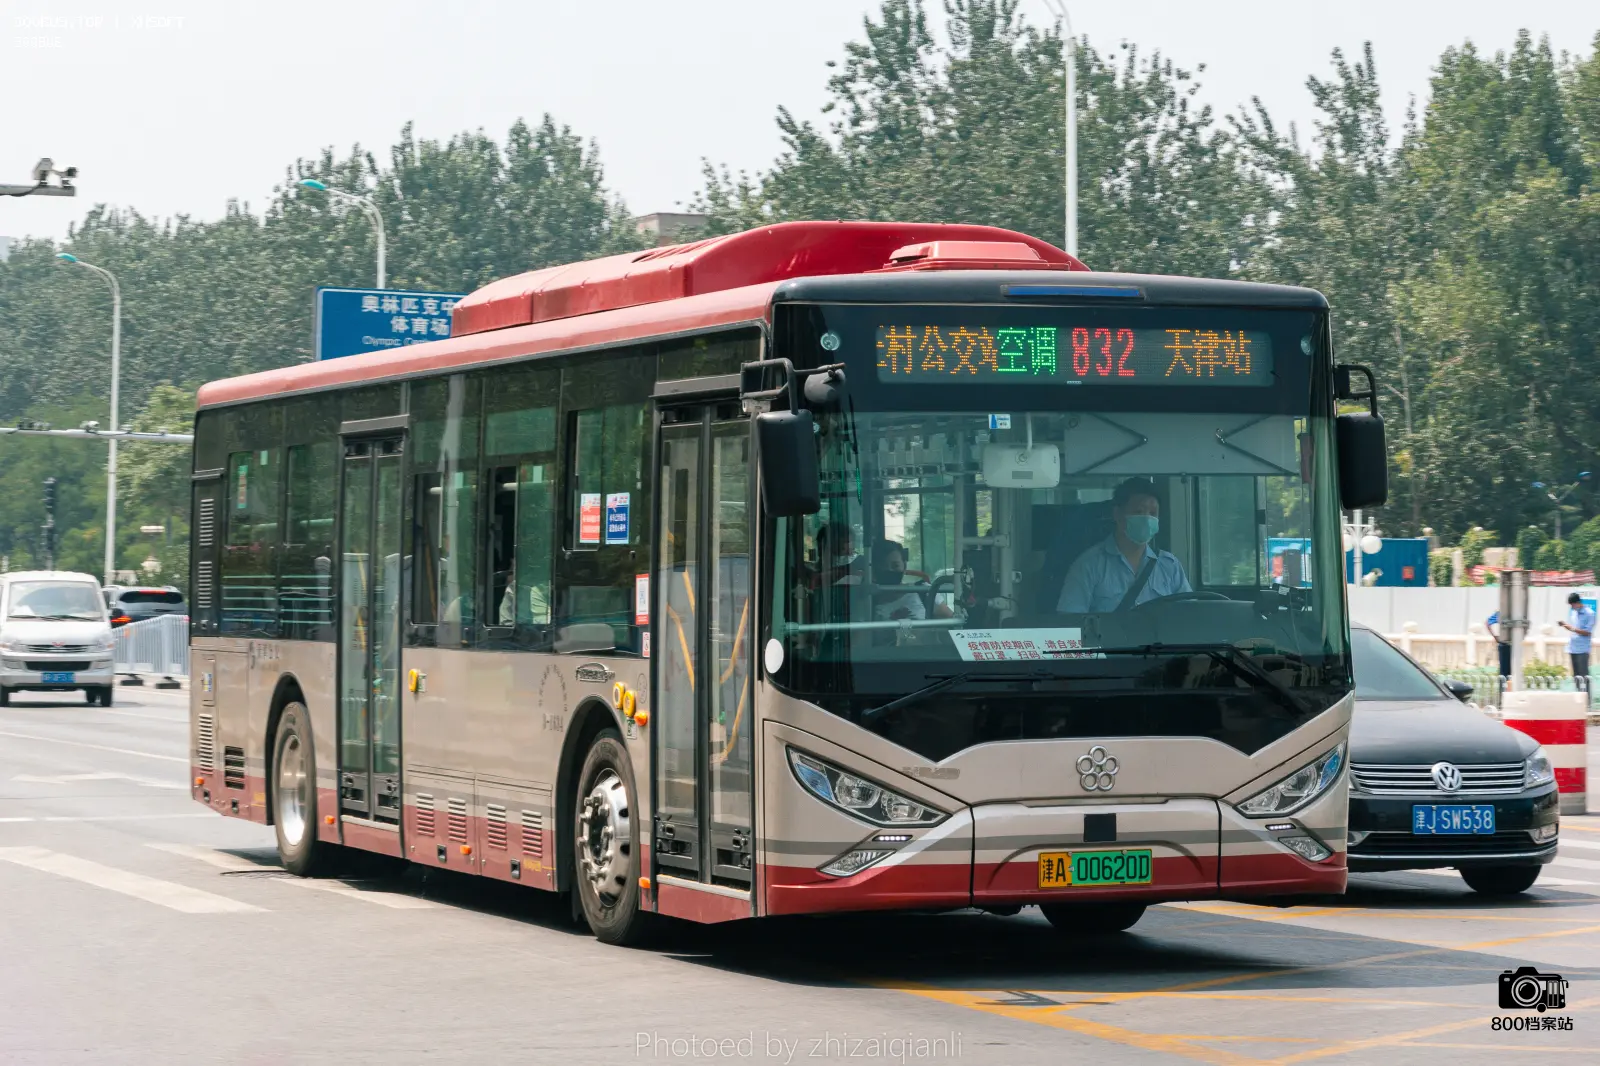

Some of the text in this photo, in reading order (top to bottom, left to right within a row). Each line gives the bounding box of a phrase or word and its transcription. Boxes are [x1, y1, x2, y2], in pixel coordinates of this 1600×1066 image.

[390, 316, 450, 336] 体育场
[996, 326, 1057, 375] 空调
[1071, 326, 1136, 377] 832
[1164, 328, 1252, 377] 天津站
